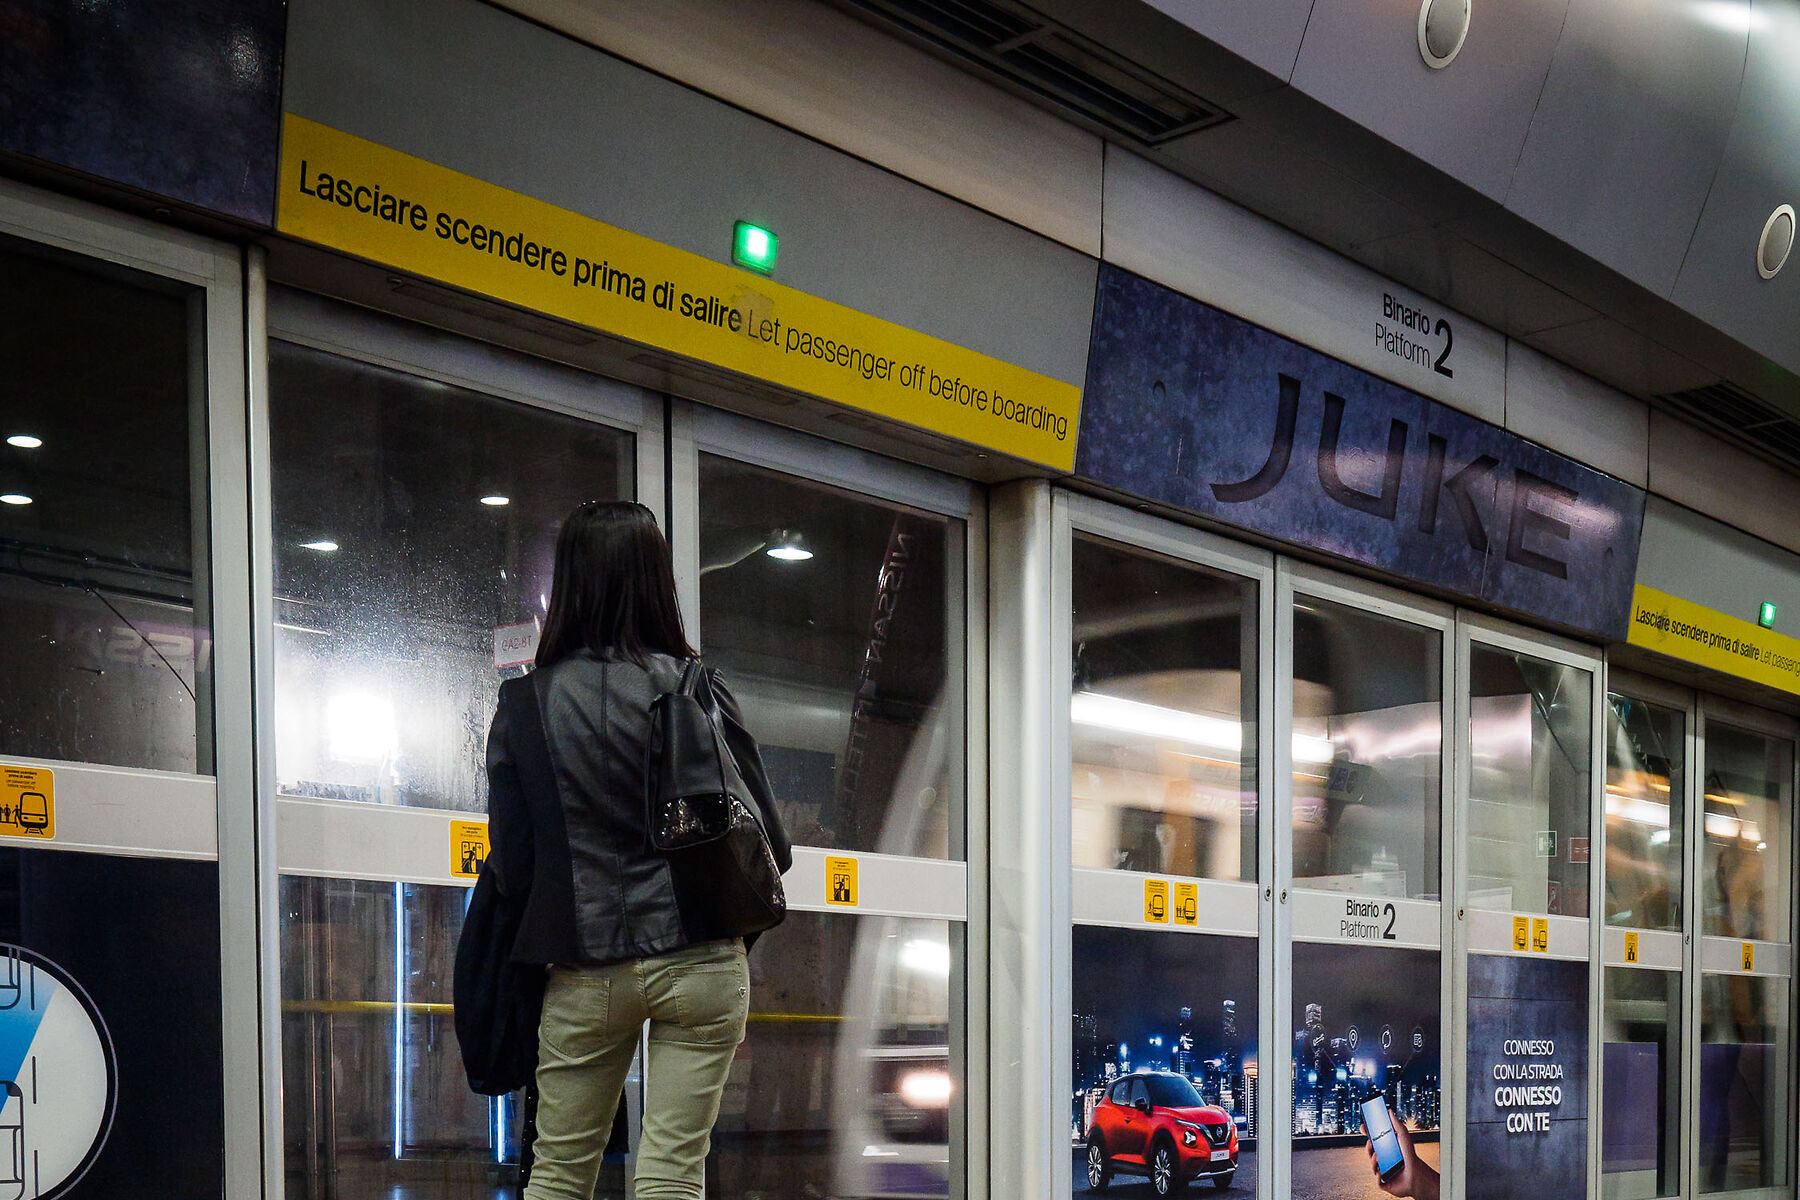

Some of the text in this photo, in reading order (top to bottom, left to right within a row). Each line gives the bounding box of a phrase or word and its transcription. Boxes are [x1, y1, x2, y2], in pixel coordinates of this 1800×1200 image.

[300, 160, 1068, 440] Lasciare scendere prima di salire Let passenger off before boarding
[1375, 321, 1431, 369] Platform
[1383, 292, 1453, 379] Binario 2
[1209, 372, 1579, 580] JUKE
[1636, 605, 1671, 631] Lasciare
[1671, 620, 1709, 644] scendere
[1709, 633, 1731, 652] prima
[1340, 919, 1380, 939] Platform
[1346, 899, 1396, 940] Binario 2
[1503, 1039, 1555, 1056] CONNESSO
[1493, 1064, 1564, 1080] CON LA STRADA
[1494, 1086, 1562, 1107] CONNESSO
[1506, 1111, 1551, 1133] CON TE
